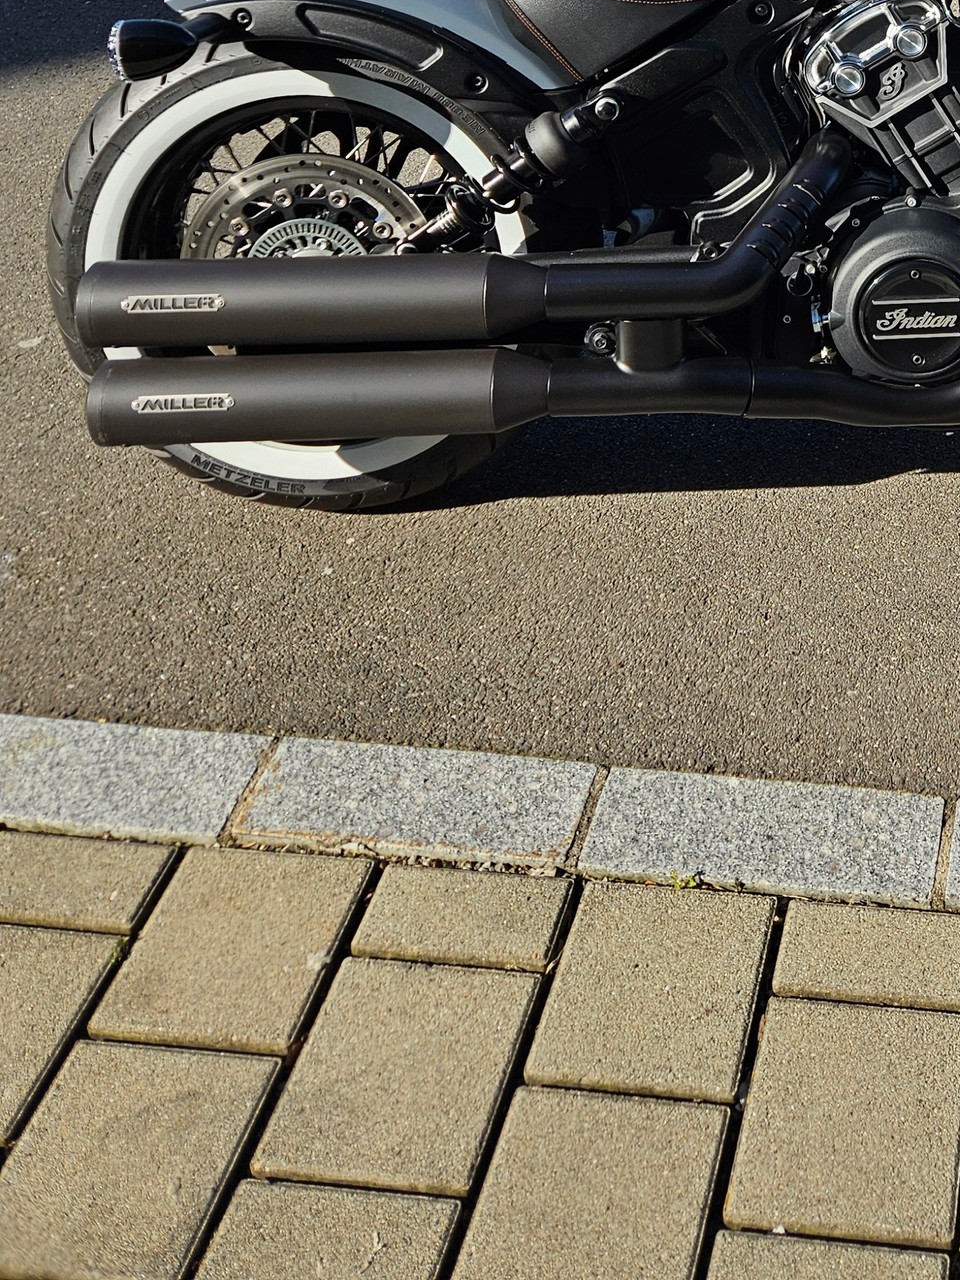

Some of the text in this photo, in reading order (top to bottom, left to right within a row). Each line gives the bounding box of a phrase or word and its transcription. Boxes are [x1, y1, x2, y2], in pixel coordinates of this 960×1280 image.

[130, 296, 215, 311] MILLER
[875, 307, 958, 331] Indian
[140, 396, 224, 411] MILLER
[190, 453, 306, 494] METZELER
